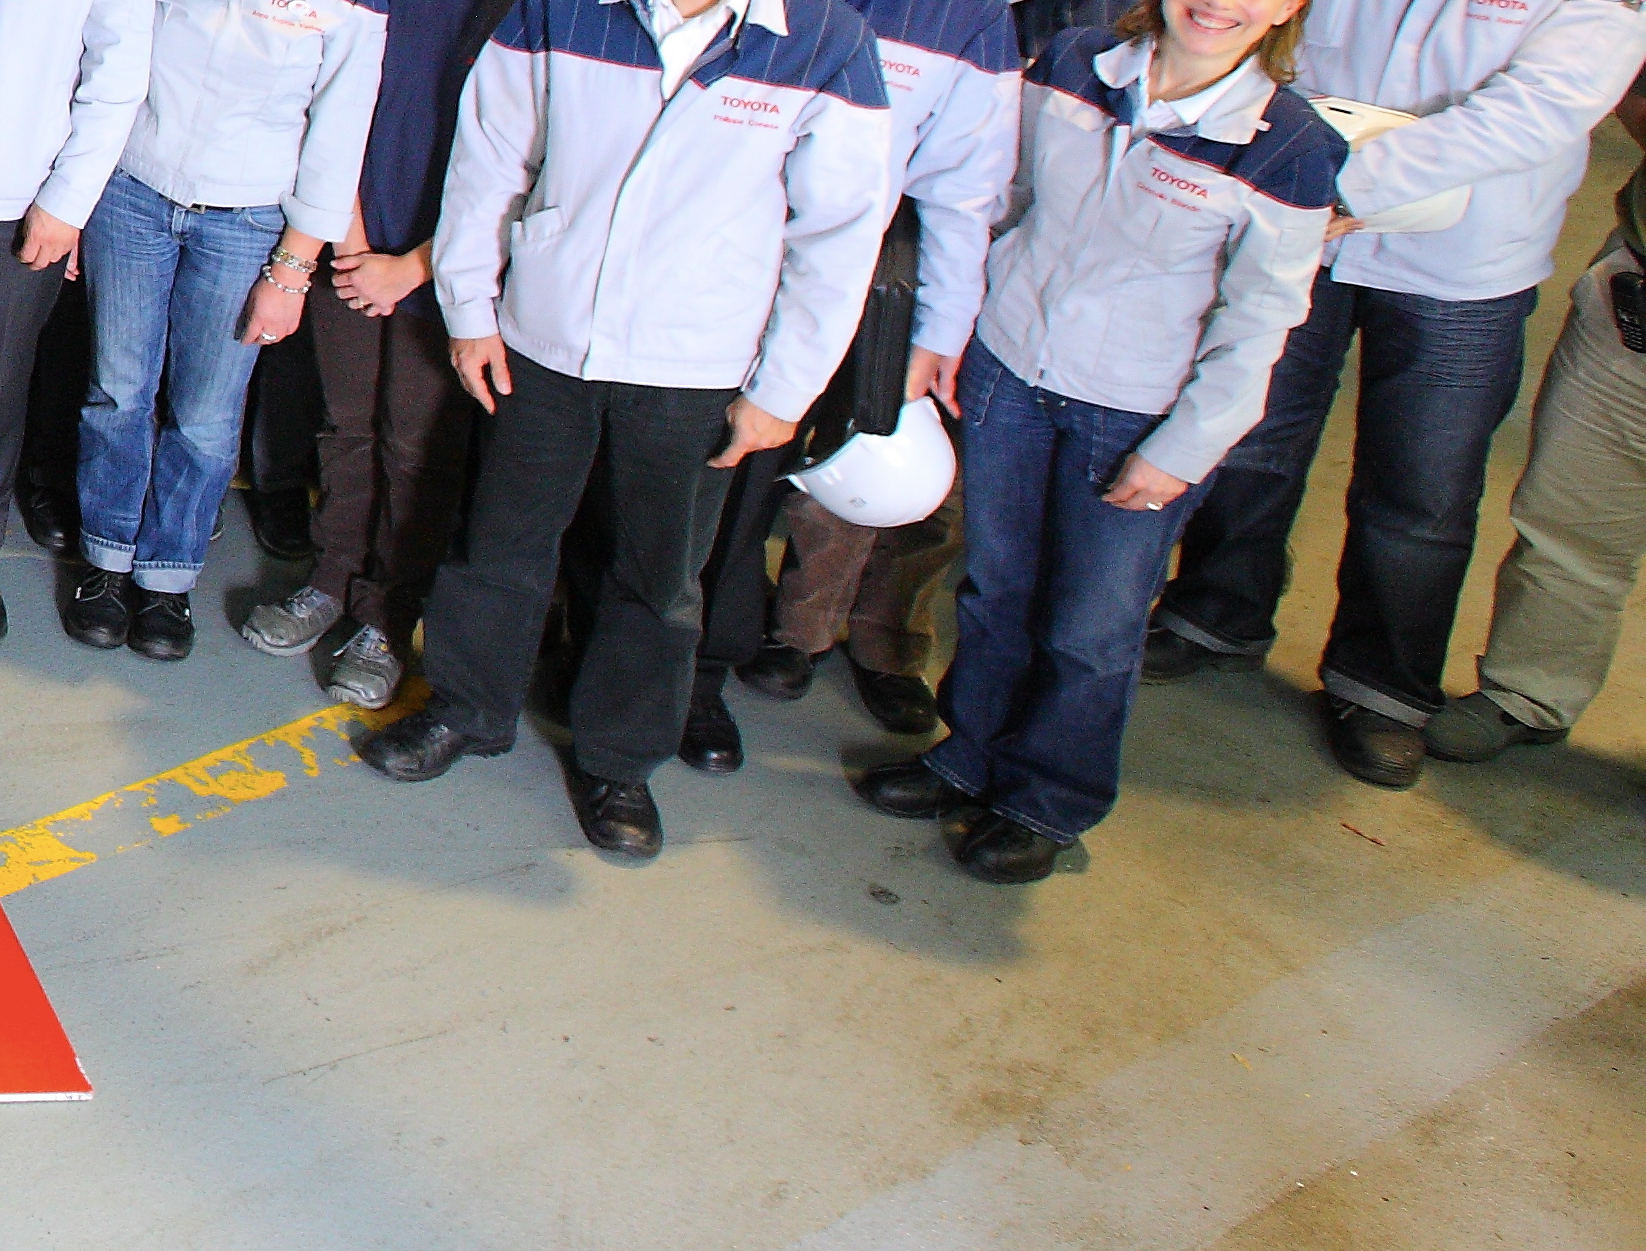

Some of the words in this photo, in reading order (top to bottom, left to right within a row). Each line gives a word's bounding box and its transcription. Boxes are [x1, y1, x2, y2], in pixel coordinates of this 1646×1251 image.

[878, 59, 921, 78] OYOTA
[721, 95, 780, 114] TOYOTA
[1151, 166, 1208, 200] TOYOTA
